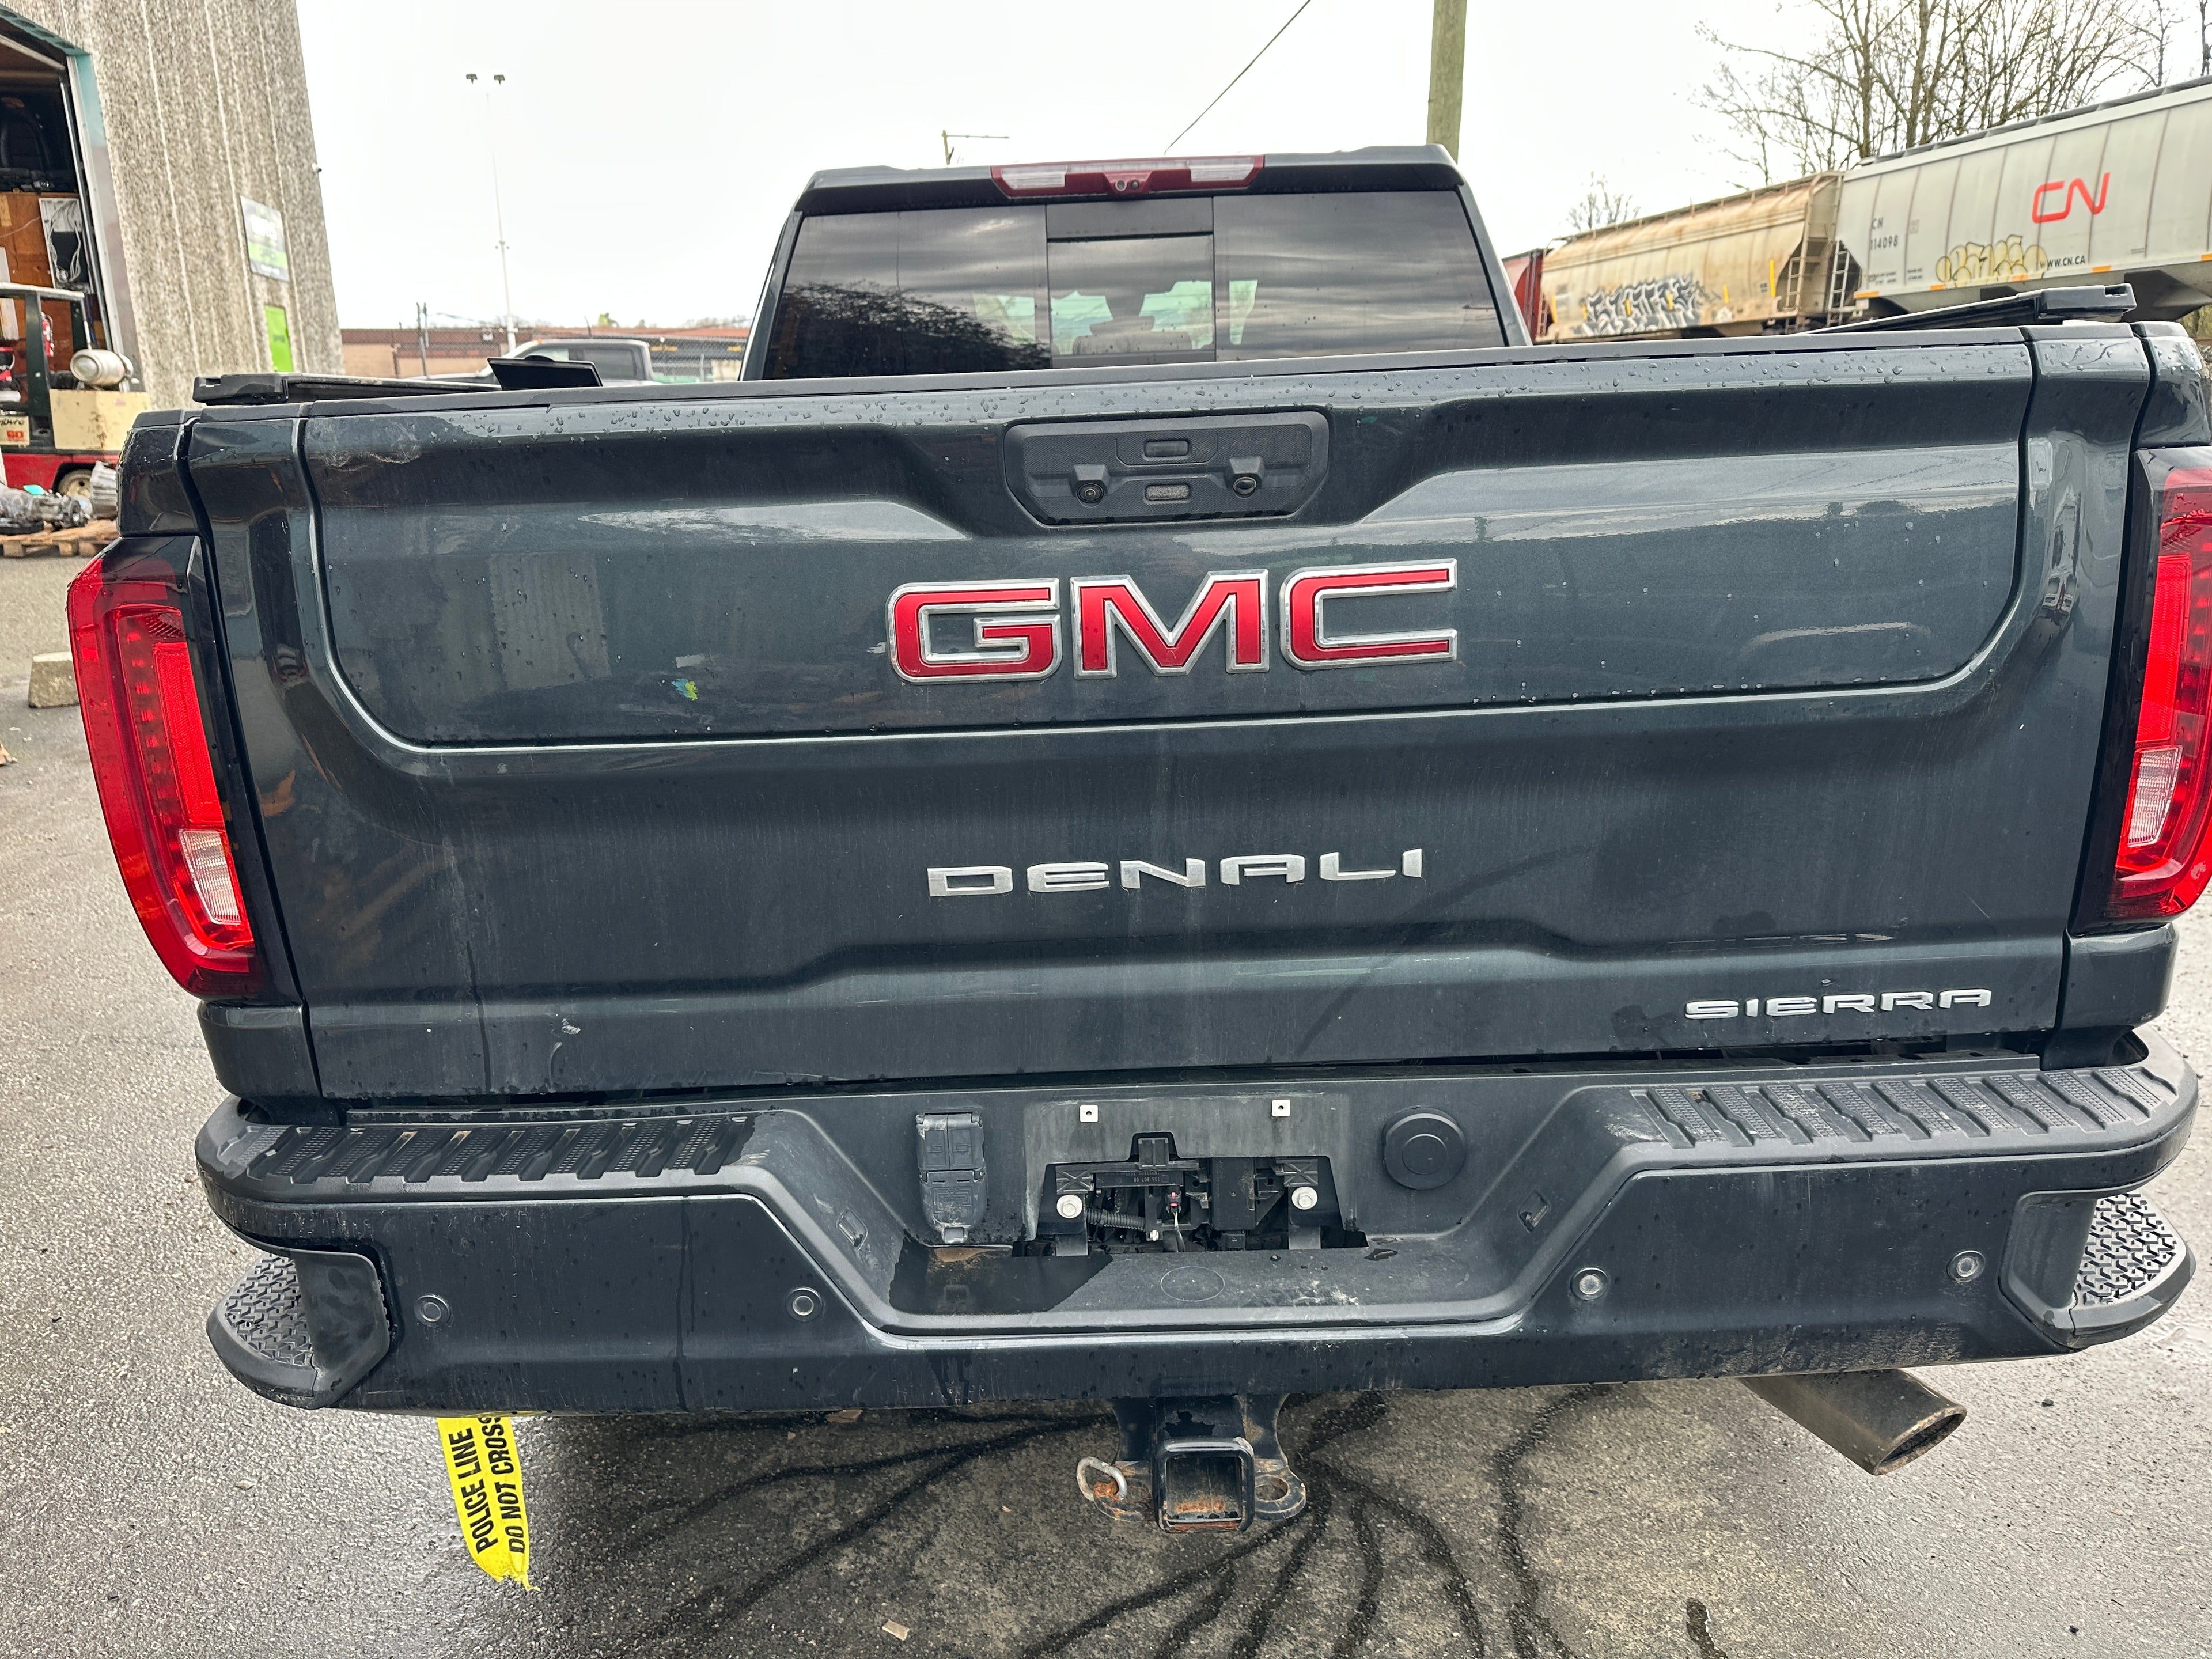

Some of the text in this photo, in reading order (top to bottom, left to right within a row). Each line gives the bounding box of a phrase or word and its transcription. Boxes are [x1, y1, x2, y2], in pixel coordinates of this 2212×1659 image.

[2032, 172, 2111, 224] CN
[1871, 217, 1884, 229] CN
[2040, 255, 2085, 268] WWW.CN.CA
[885, 558, 1457, 685] GMC
[927, 848, 1422, 896] DENALI
[1685, 988, 1991, 1019] SIERRA
[448, 1427, 498, 1554] POLICE LINE
[495, 1482, 522, 1520] NOT
[505, 1525, 525, 1554] DO
